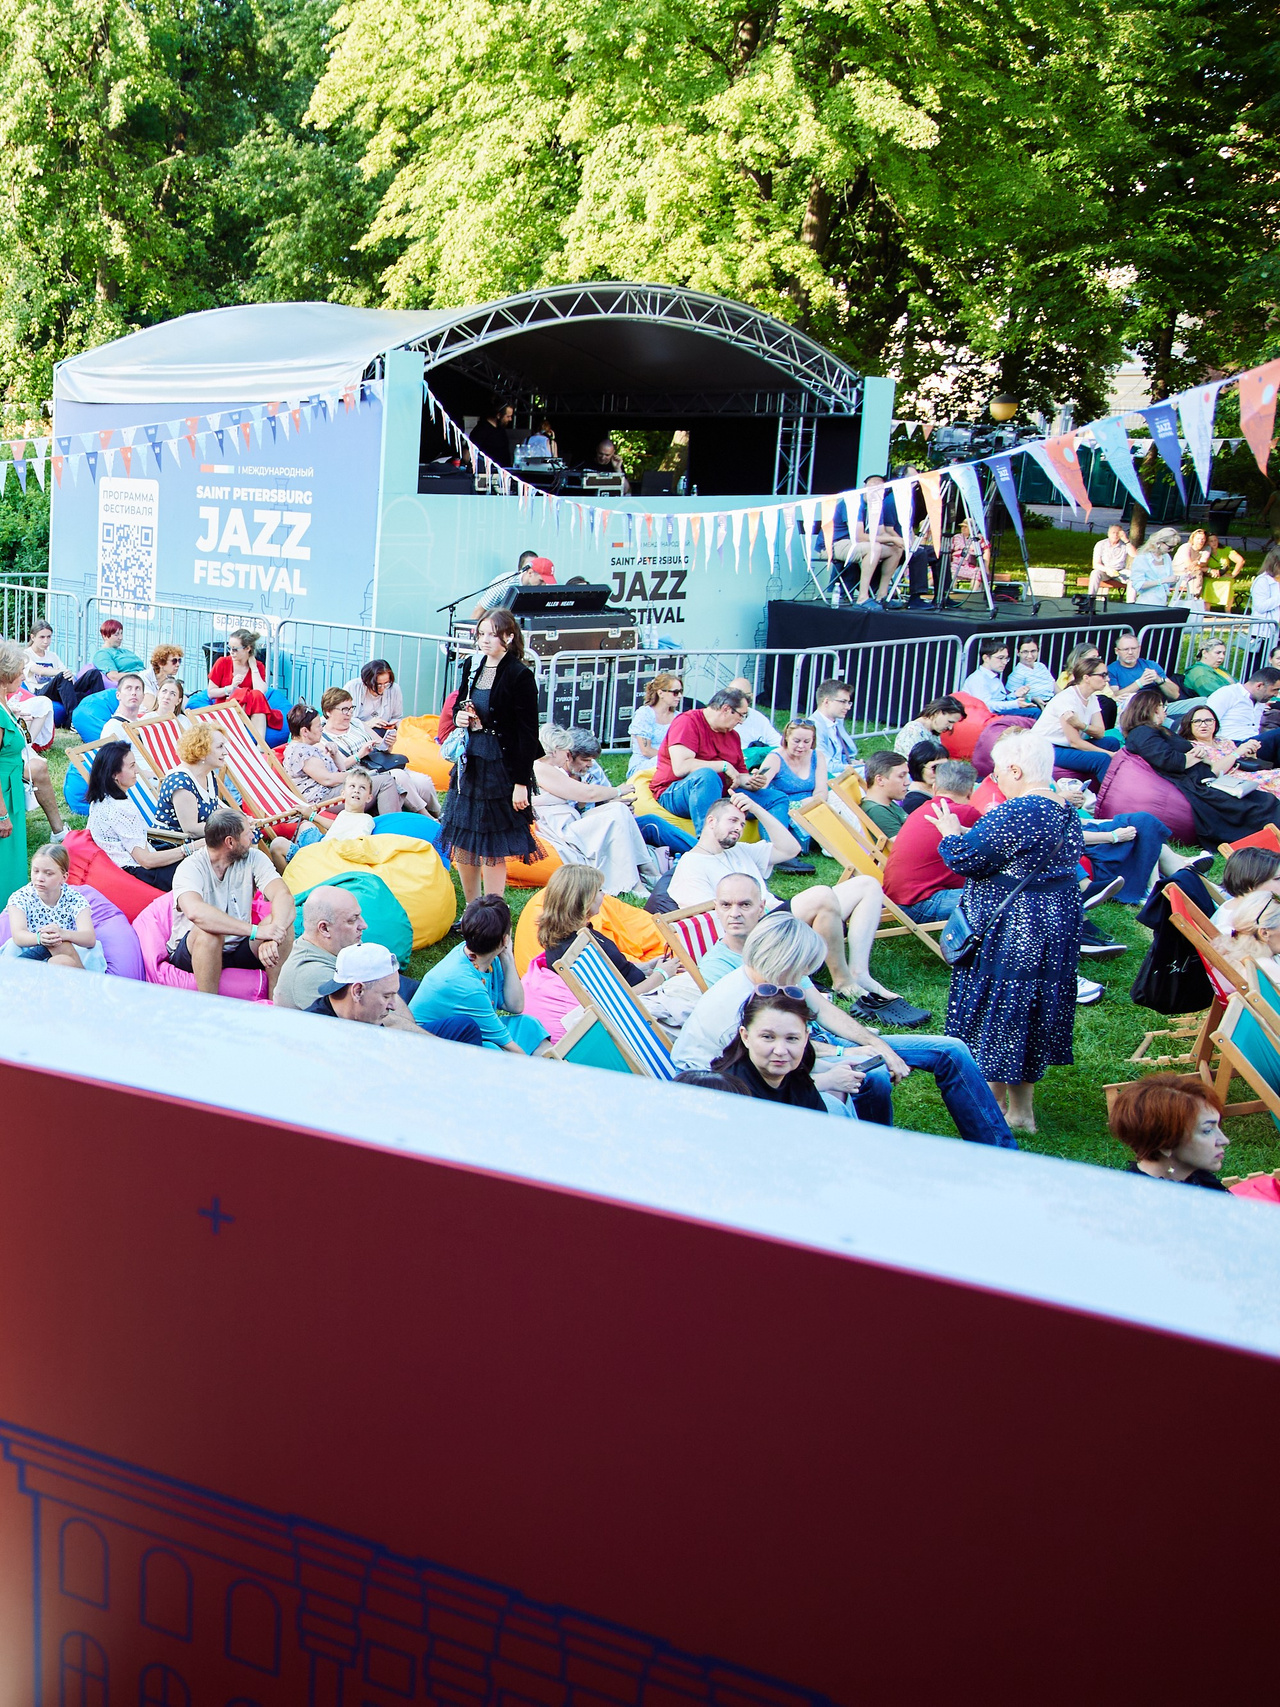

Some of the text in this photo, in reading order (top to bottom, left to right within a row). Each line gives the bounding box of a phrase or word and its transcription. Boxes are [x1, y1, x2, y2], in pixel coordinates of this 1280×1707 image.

[241, 466, 314, 478] МЕЖДУНАРОДНЫЙ
[102, 490, 154, 502] ПРОГРАММА
[196, 485, 313, 505] SAINT PETERSBURG
[103, 503, 153, 516] ФЕСТИВАЛЯ
[195, 506, 312, 560] JAZZ
[610, 557, 635, 566] SAINT
[193, 559, 308, 596] FESTIVAL
[609, 570, 688, 603] JAZZ
[629, 607, 685, 625] STIVAL
